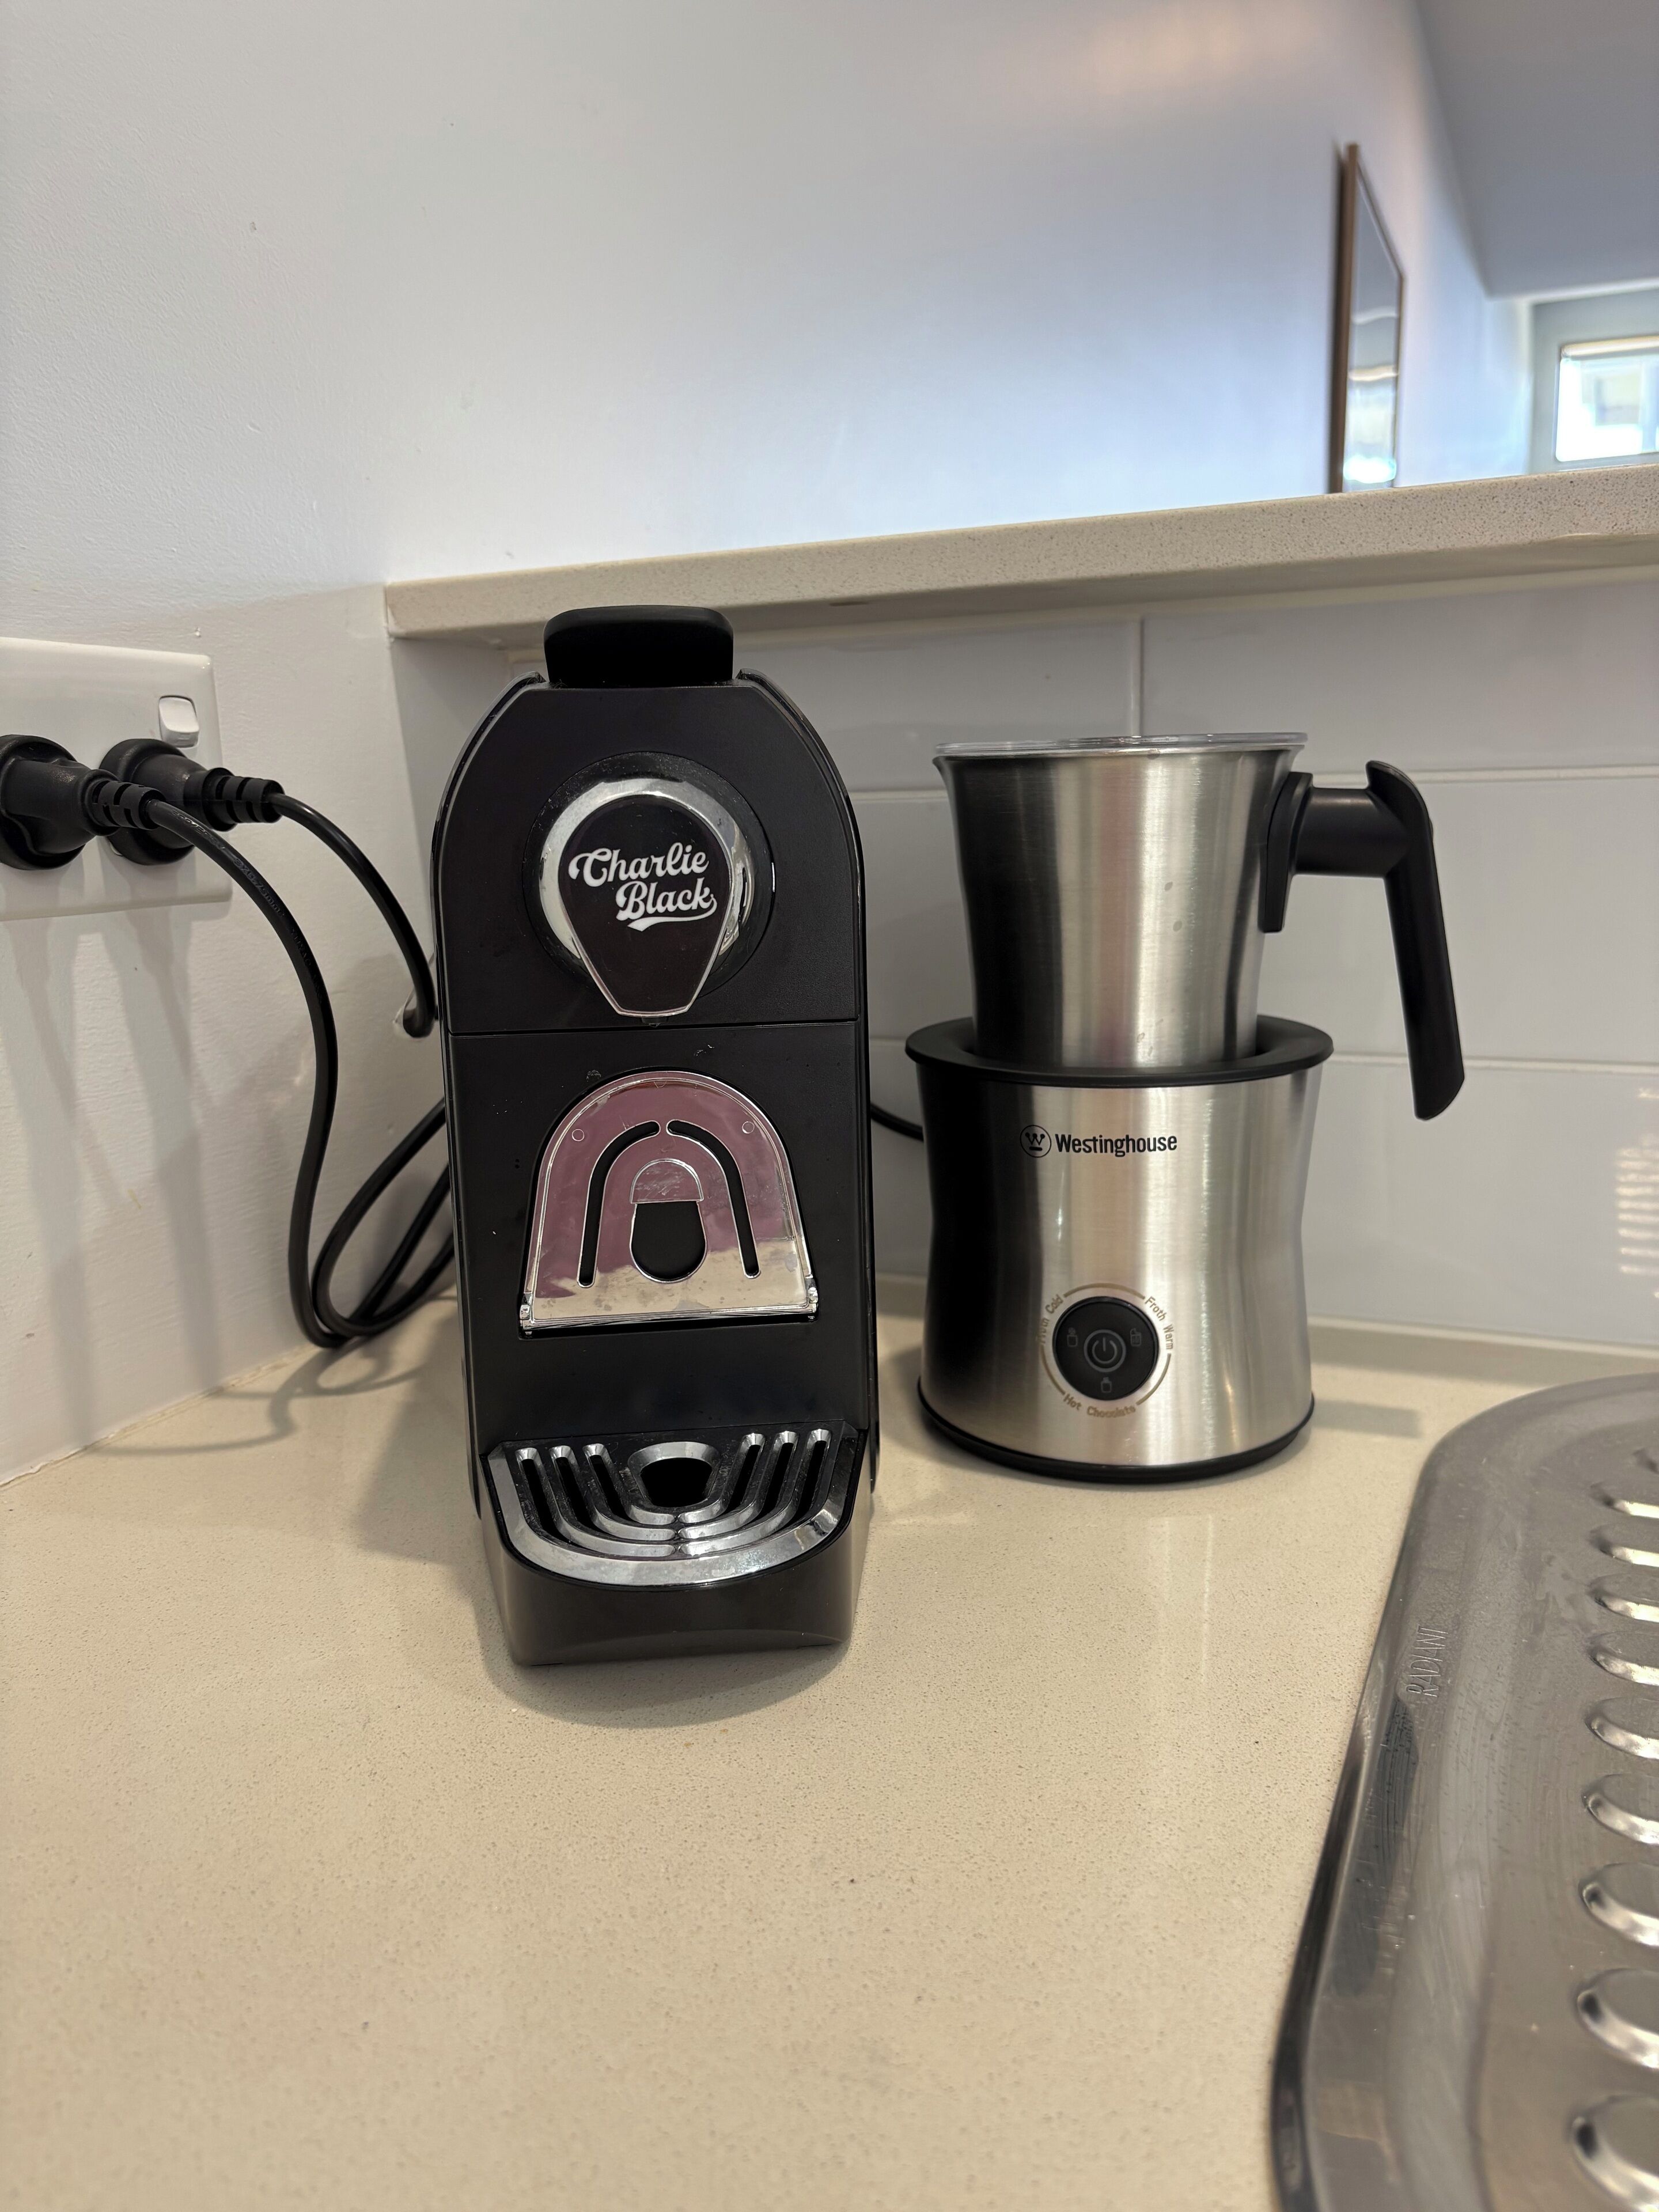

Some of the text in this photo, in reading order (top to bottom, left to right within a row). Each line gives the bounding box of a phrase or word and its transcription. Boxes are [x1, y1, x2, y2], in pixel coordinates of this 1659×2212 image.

[568, 842, 709, 887] Charlie
[616, 877, 717, 931] Black
[1055, 1134, 1177, 1157] Westinghouse
[1046, 1294, 1064, 1314] Cold
[1145, 1296, 1173, 1350] Froth Warm
[1063, 1394, 1082, 1411] Hot
[1406, 1624, 1449, 1698] RADIANT
